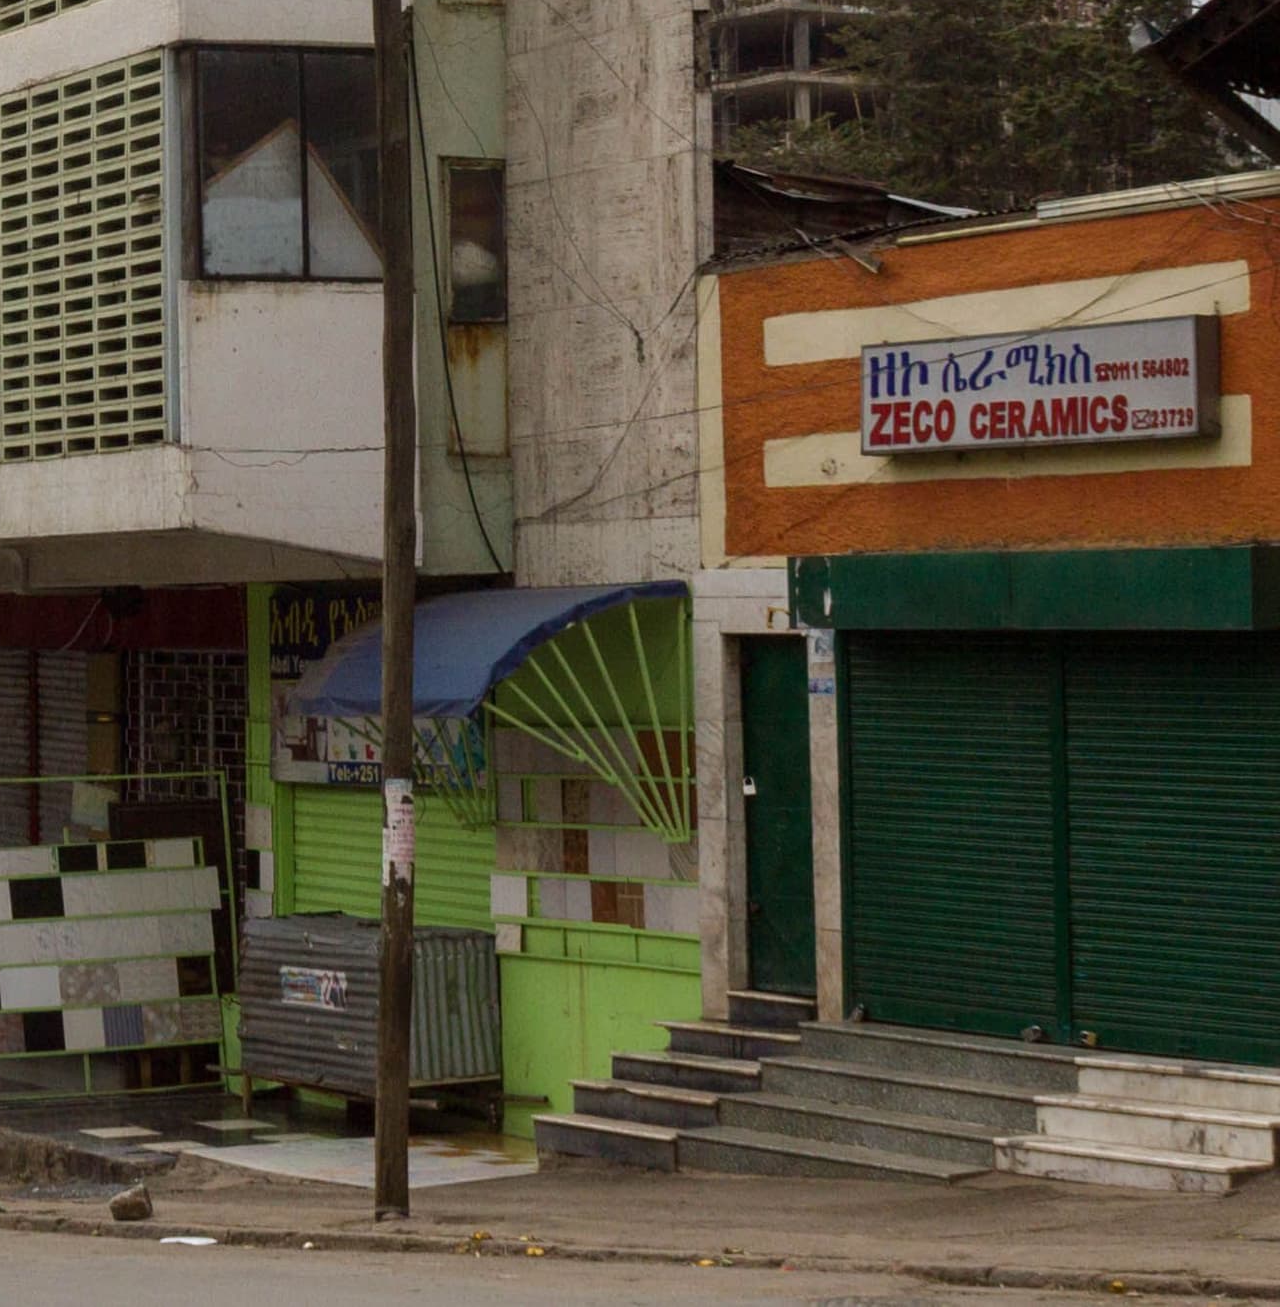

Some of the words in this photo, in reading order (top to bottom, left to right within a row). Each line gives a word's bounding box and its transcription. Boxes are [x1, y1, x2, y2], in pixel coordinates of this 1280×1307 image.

[869, 399, 956, 446] ZECO
[969, 394, 1129, 440] CERAMICS
[1150, 407, 1194, 429] 23729
